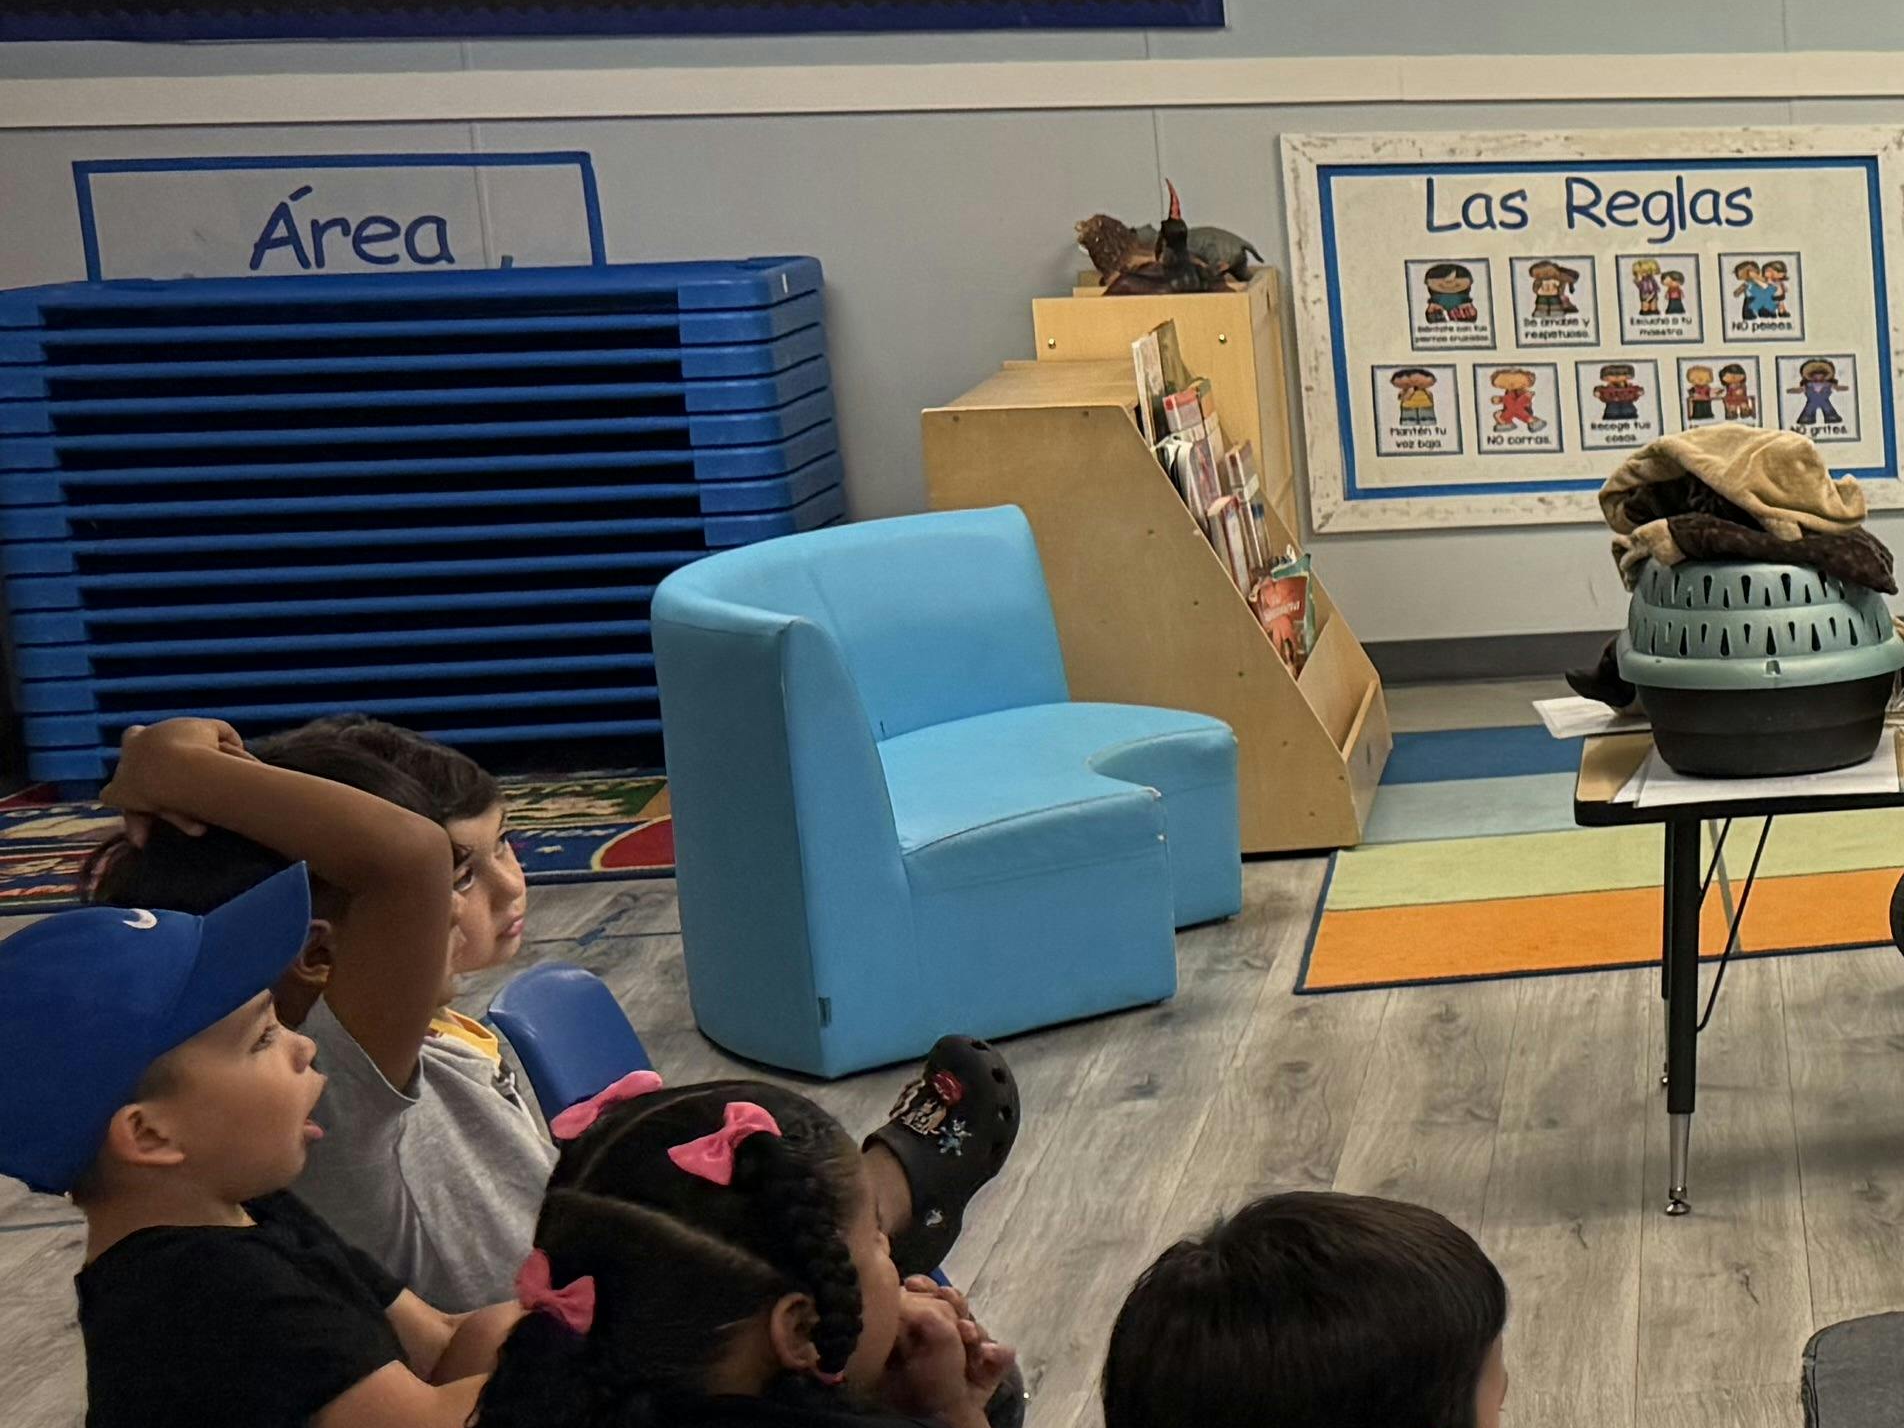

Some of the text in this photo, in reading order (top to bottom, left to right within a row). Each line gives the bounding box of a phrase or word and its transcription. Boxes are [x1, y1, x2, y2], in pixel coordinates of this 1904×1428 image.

[249, 184, 456, 271] Área
[1426, 175, 1754, 244] Las Reglas
[1731, 321, 1748, 332] NO
[1487, 435, 1504, 445] NO
